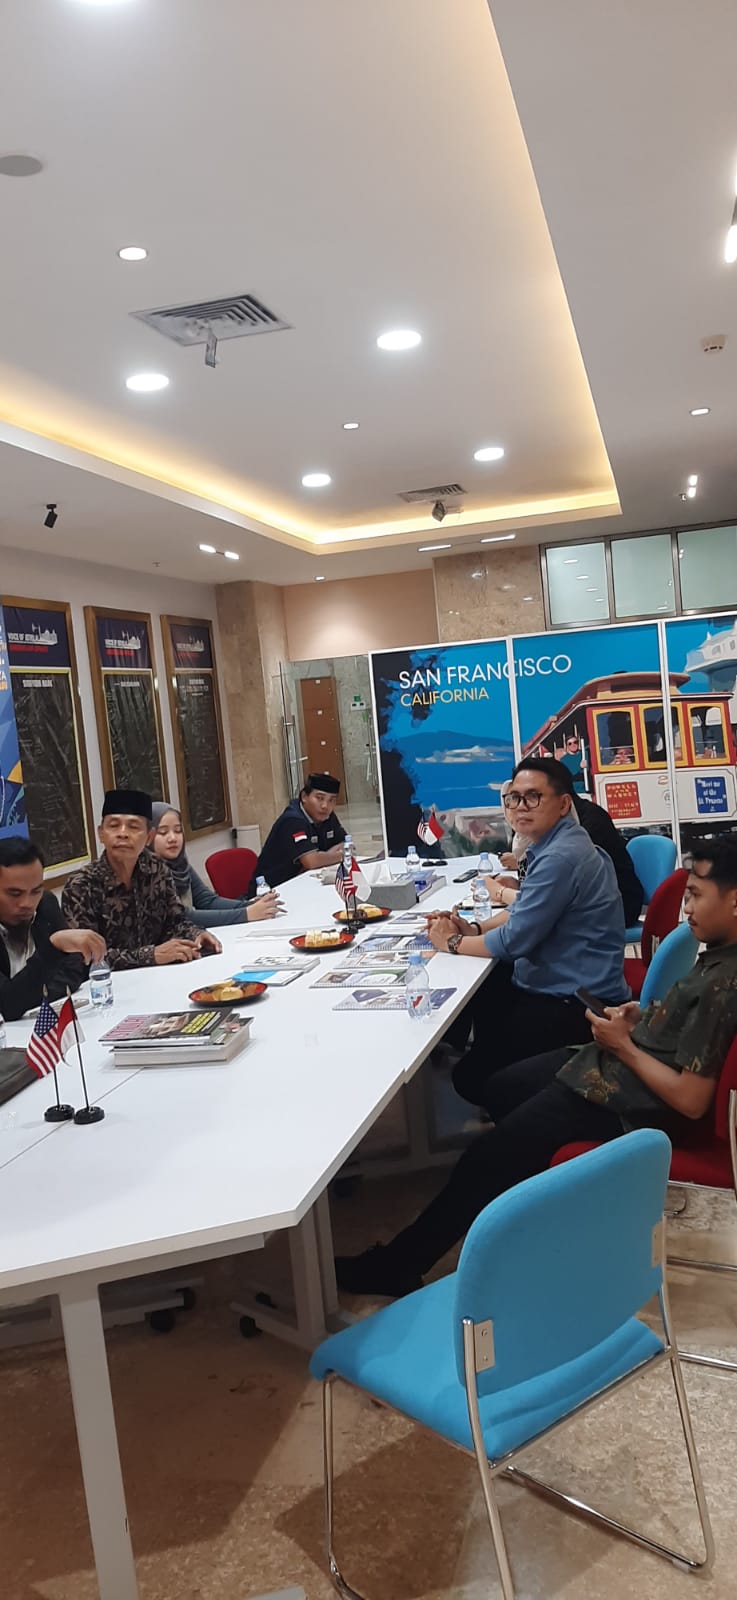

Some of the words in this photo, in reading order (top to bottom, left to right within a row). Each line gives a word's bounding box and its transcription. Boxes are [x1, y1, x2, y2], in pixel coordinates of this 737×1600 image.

[399, 668, 441, 689] SAN
[447, 654, 572, 684] FRANCISCO
[400, 687, 490, 707] CALIFORNIA
